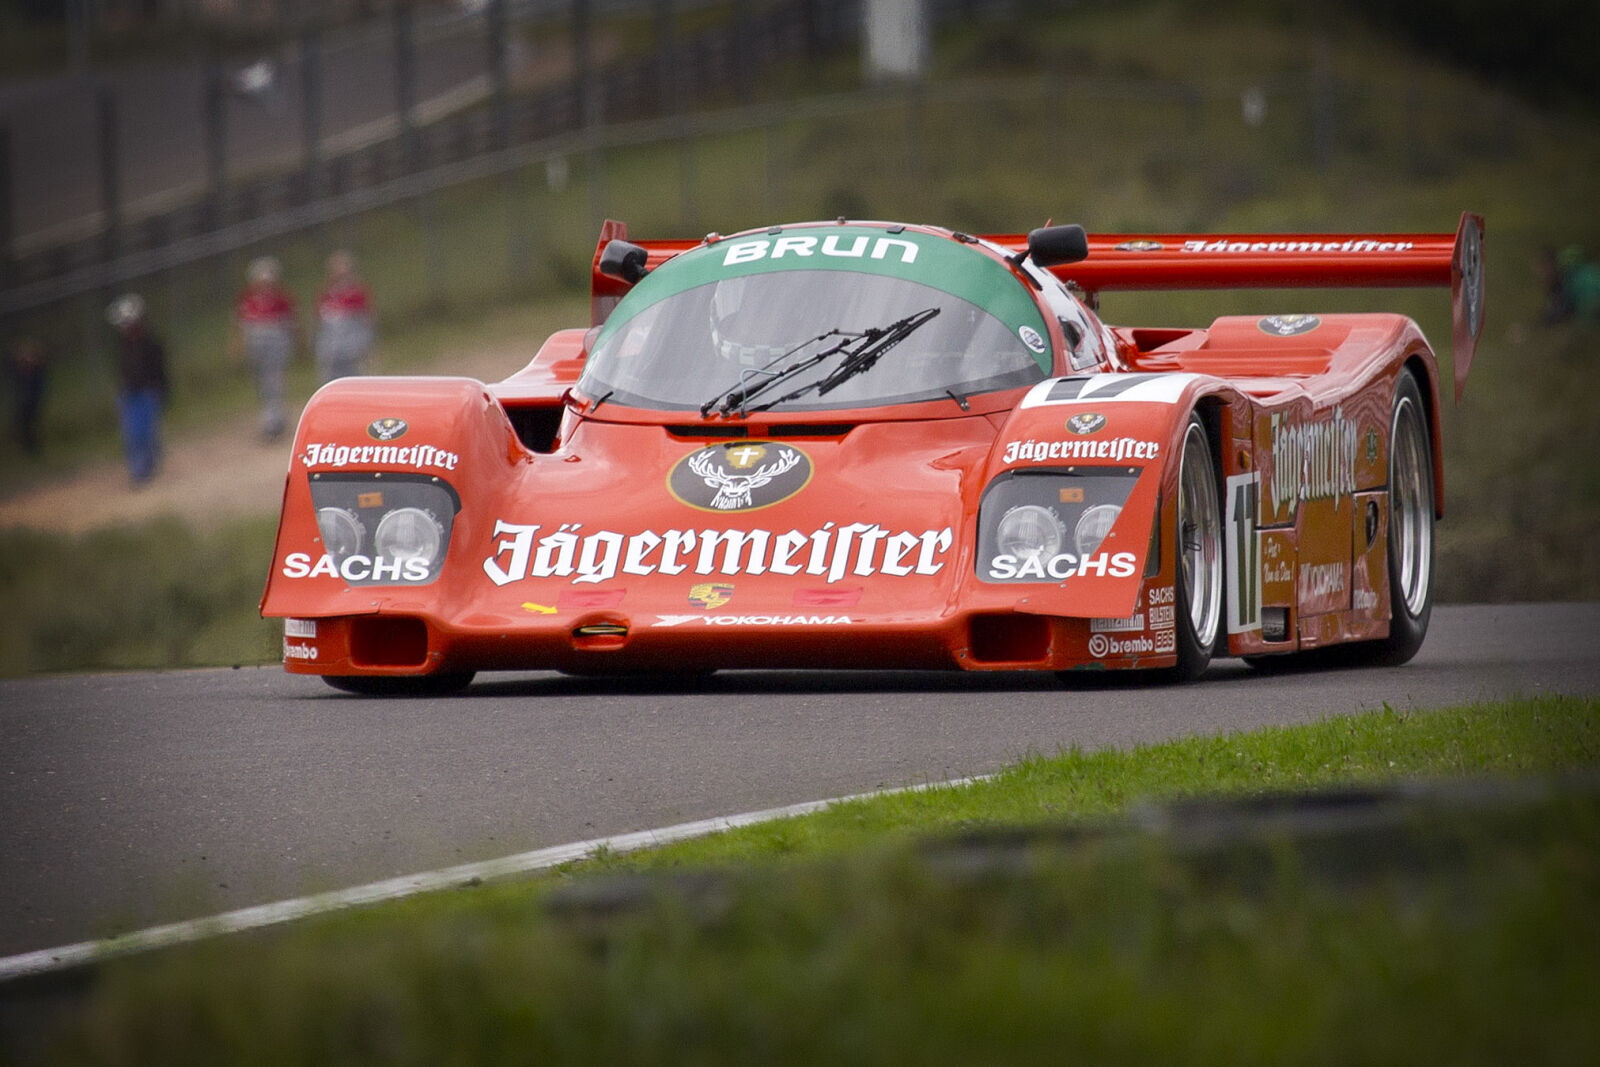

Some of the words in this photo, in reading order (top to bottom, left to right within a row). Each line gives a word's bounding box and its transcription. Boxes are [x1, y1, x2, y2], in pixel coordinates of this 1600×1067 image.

[722, 235, 919, 266] BRUN
[283, 552, 430, 581] SACHS
[989, 552, 1136, 579] SACHS
[1149, 586, 1174, 605] SACHS
[702, 614, 852, 625] YOKOHAMA
[1149, 606, 1174, 623] BILSTEIN
[1110, 635, 1154, 654] brembo
